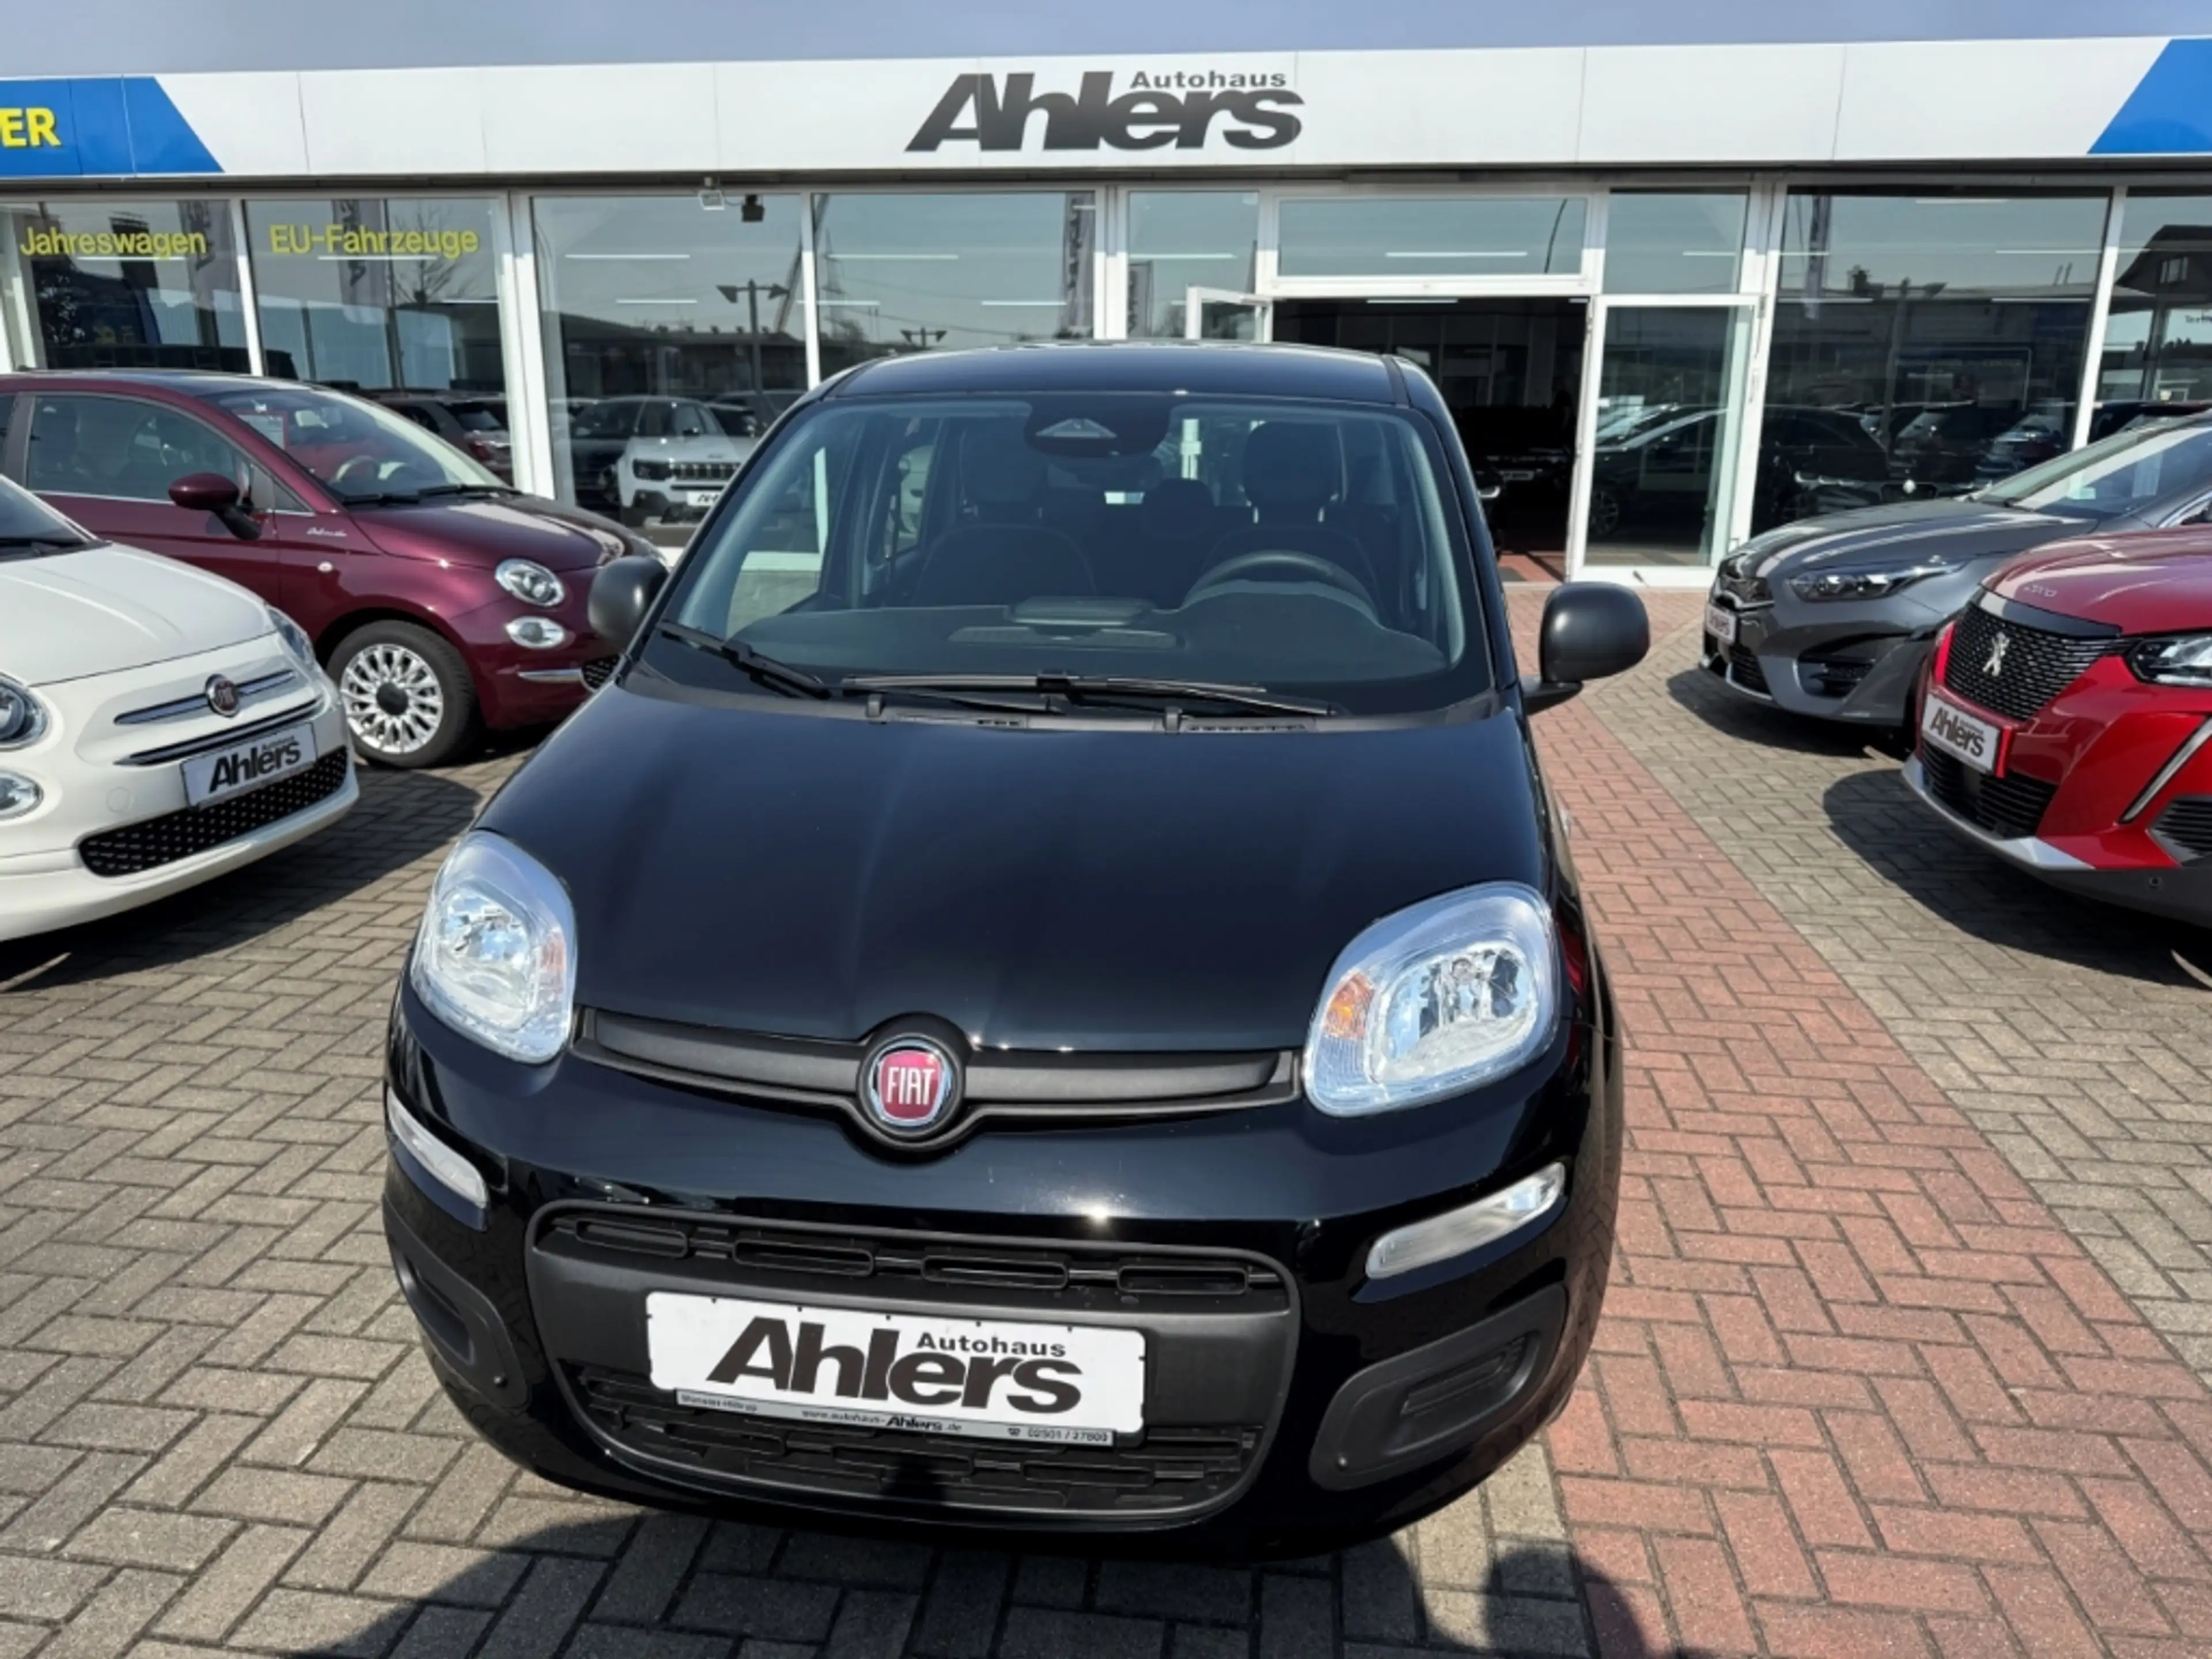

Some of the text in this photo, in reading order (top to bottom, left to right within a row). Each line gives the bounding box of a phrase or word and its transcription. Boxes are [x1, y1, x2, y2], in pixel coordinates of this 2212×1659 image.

[1130, 70, 1287, 88] Autohaus
[904, 71, 1306, 151] Ahlers
[20, 226, 207, 259] Jahreswagen
[269, 224, 479, 259] EU-Fahrzeuge
[1929, 707, 1986, 757] Ahlers
[209, 740, 301, 794] Ahlers
[886, 1066, 935, 1105] FIAT
[916, 1332, 1066, 1357] Autohaus
[706, 1316, 1084, 1414] Ahlers
